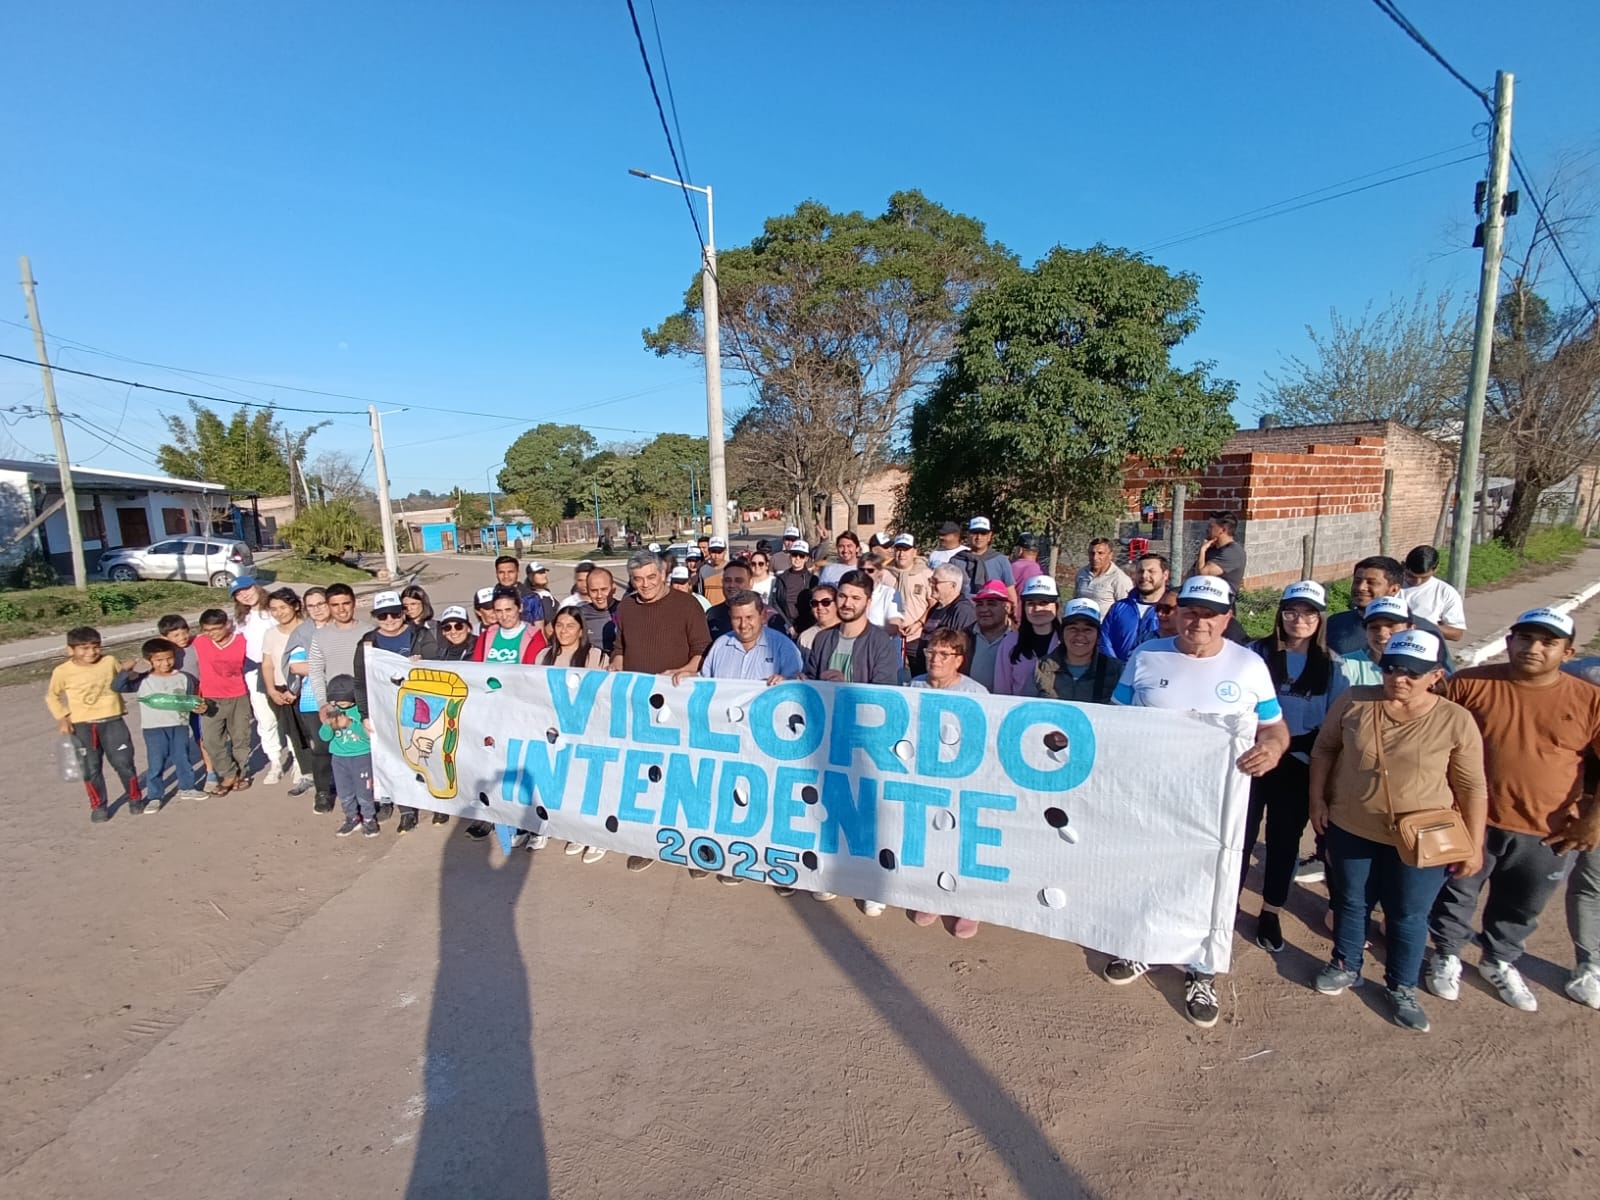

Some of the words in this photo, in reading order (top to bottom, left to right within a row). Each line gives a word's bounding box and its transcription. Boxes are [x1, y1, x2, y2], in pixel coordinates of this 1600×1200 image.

[547, 668, 1095, 792] VILLORDO
[501, 738, 1017, 883] INTENDENTE
[656, 828, 799, 885] 2025
